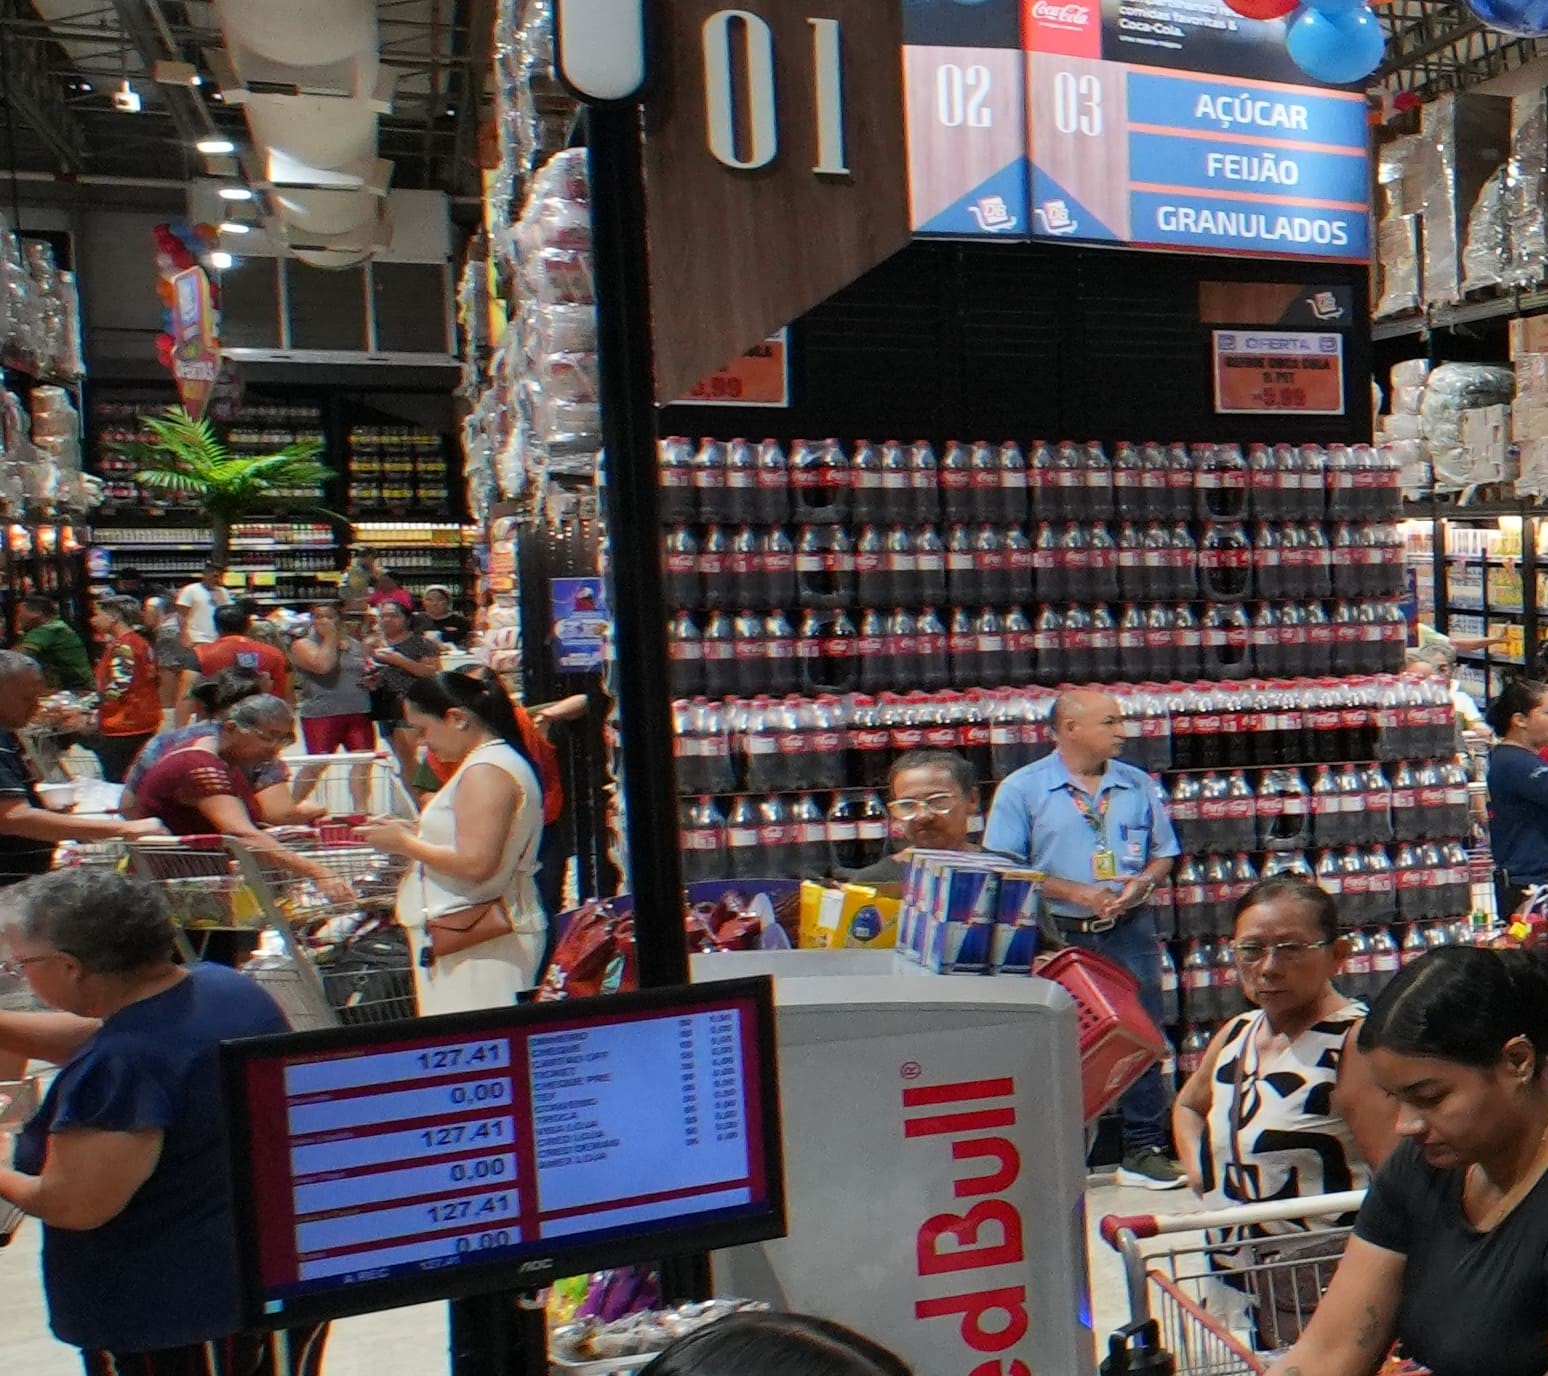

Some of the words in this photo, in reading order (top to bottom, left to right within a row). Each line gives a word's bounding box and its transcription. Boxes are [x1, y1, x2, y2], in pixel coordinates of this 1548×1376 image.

[702, 8, 851, 177] 01
[936, 64, 992, 128] 02
[1055, 72, 1103, 136] 03
[1195, 93, 1309, 131] AÇÚCAR
[1207, 152, 1299, 185] FEIJÃO
[1157, 204, 1348, 246] GRANULADOS
[417, 1043, 501, 1071] 127.41
[450, 1080, 505, 1105] 0.00
[420, 1119, 504, 1148] 127.41
[450, 1157, 505, 1182] 0.00
[903, 1076, 1025, 1277] Bull
[427, 1194, 510, 1224] 127.41
